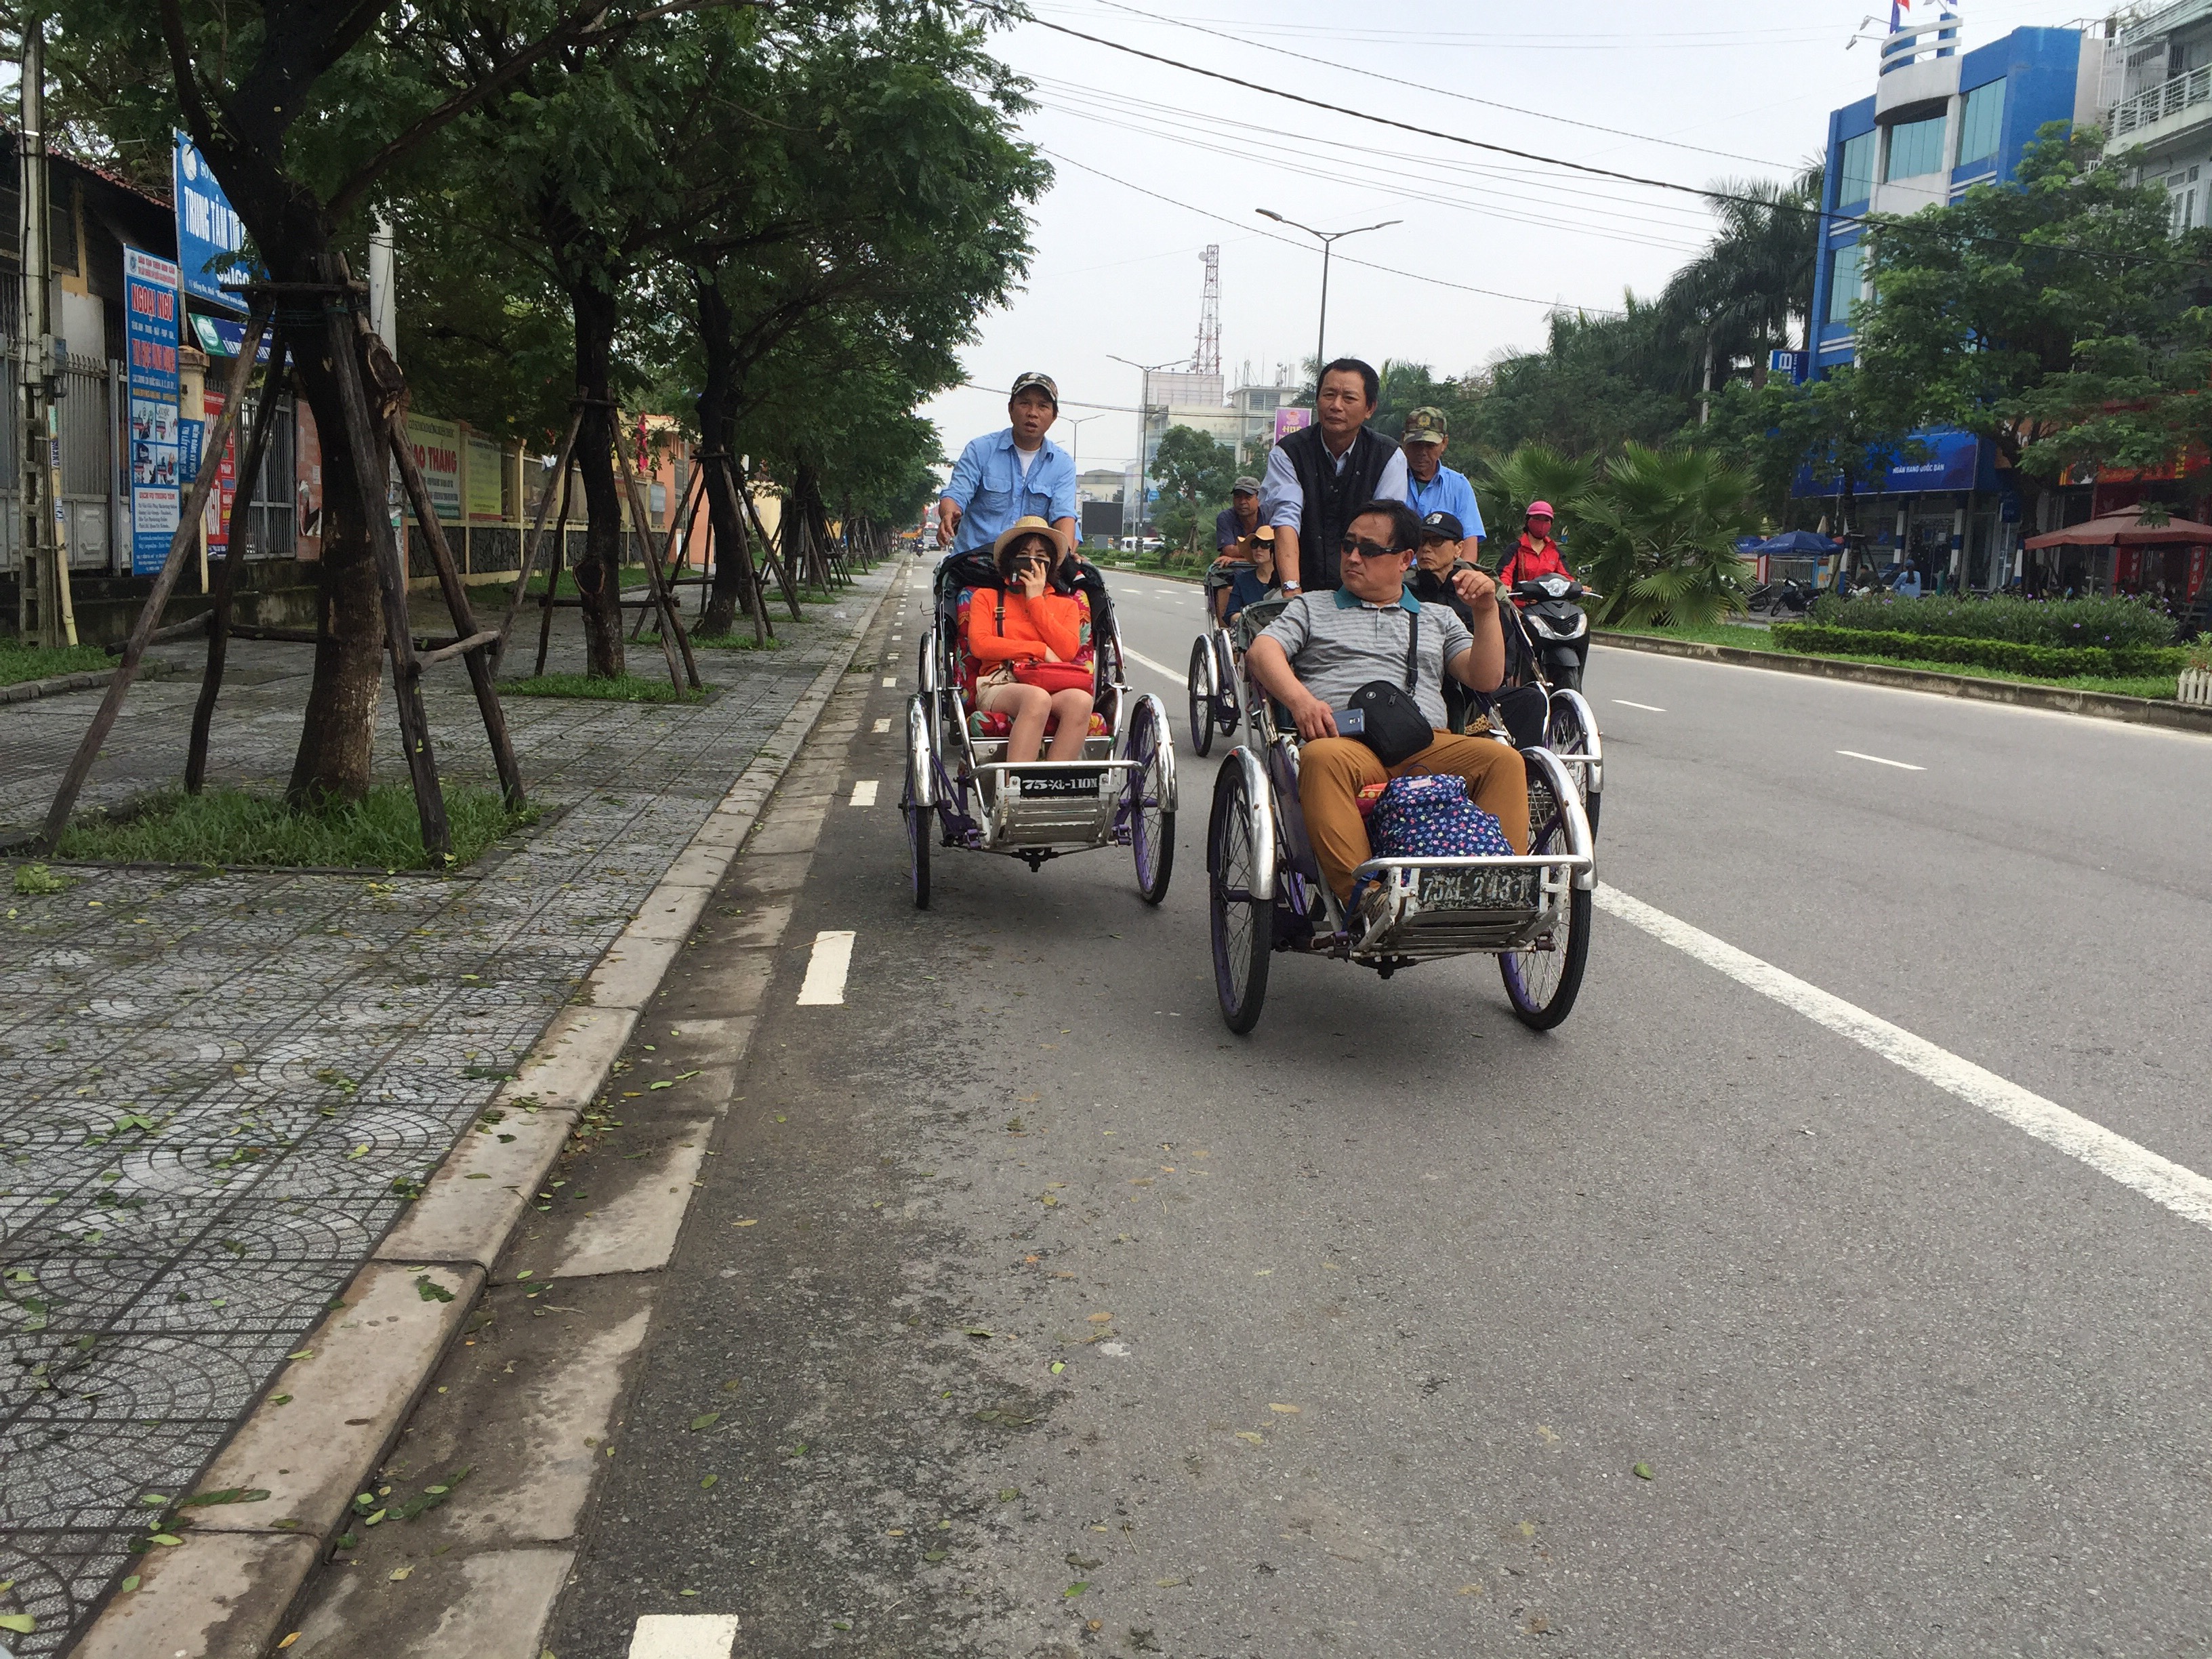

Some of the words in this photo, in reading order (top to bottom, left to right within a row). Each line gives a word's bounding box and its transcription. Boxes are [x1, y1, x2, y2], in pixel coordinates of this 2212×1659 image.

[184, 186, 209, 242] TRUNG
[210, 194, 228, 250] TÂM
[131, 283, 157, 322] NGOẠI
[157, 289, 174, 322] NGỮ
